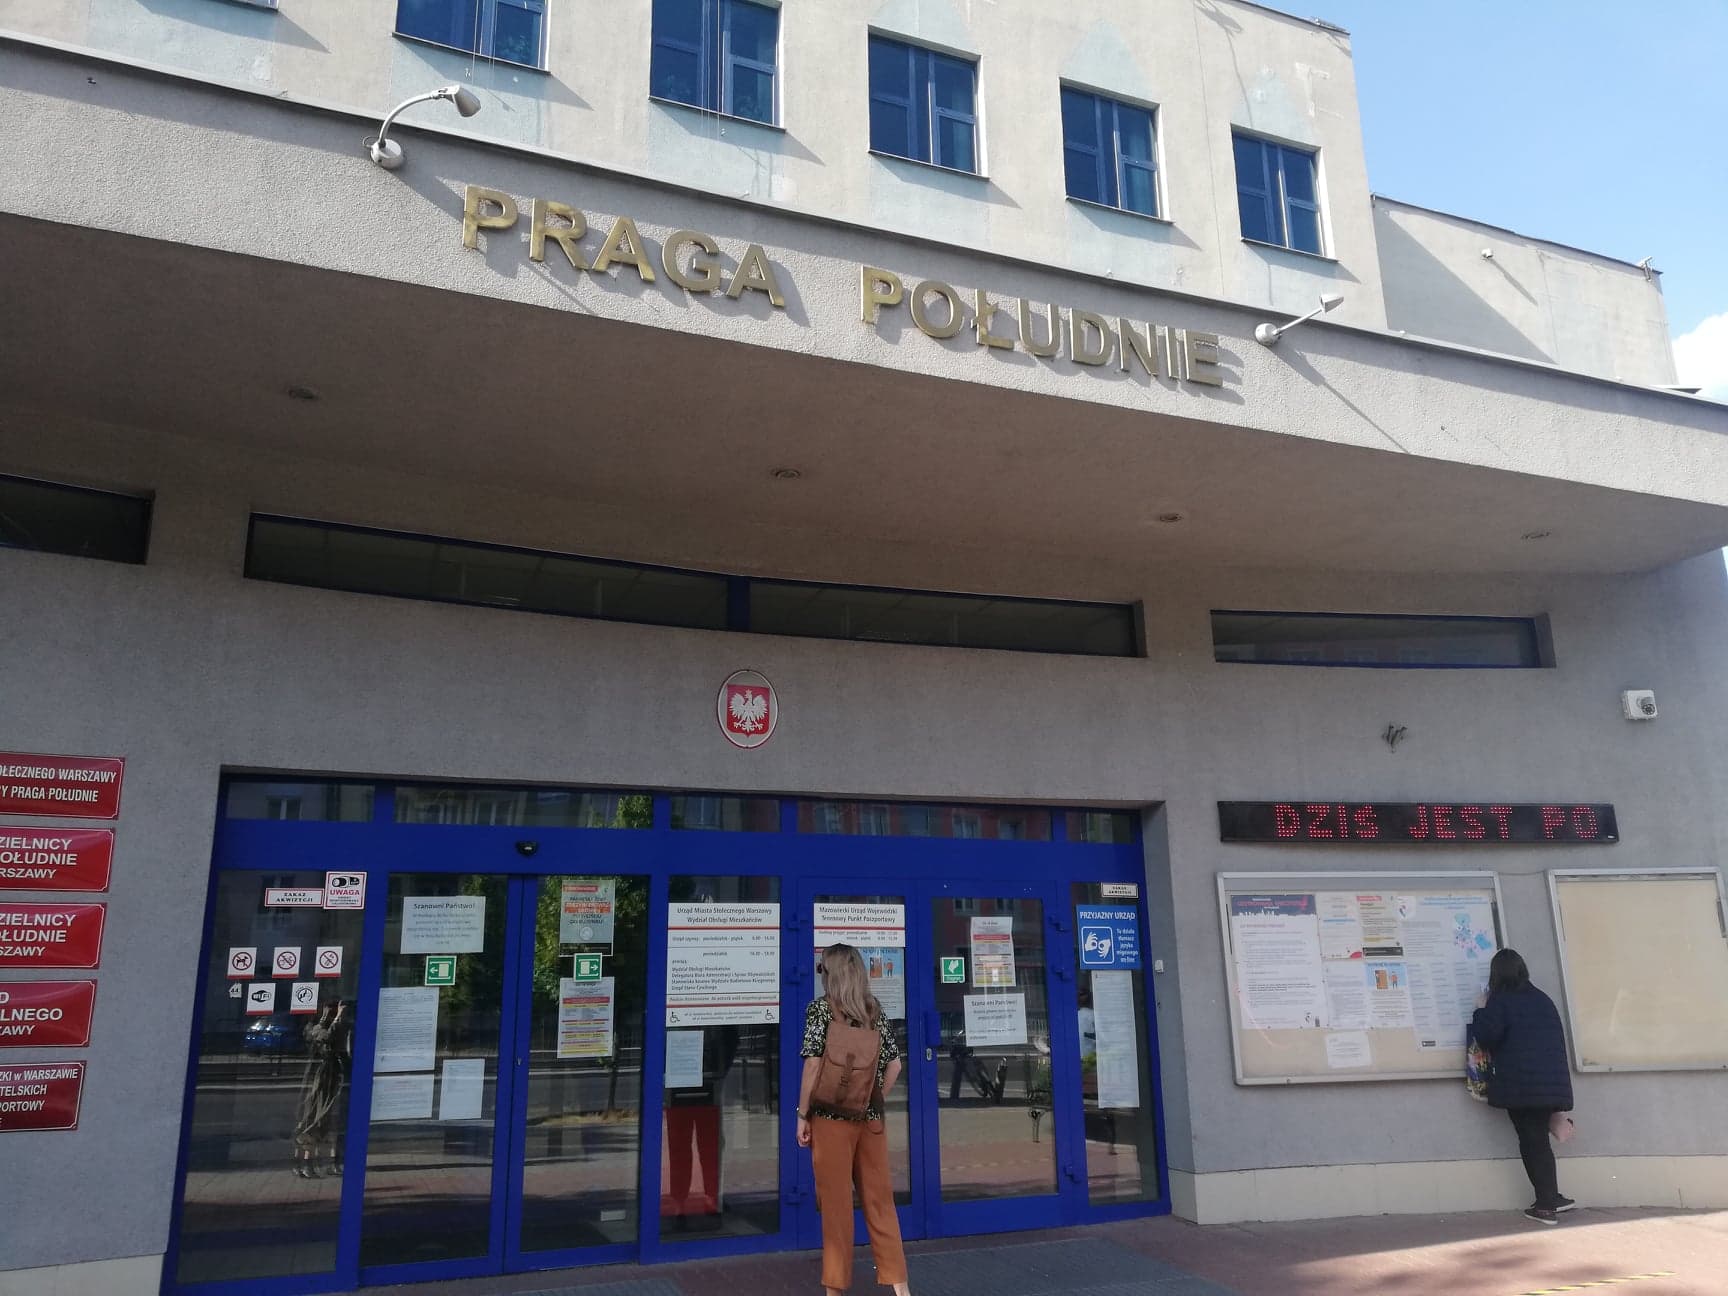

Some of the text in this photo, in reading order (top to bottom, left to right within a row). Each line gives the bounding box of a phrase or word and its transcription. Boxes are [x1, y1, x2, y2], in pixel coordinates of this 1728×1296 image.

[463, 184, 1224, 387] PRAGA POŁUDNIE
[58, 768, 117, 783] WARSZAWY
[11, 786, 45, 799] PRAGA
[48, 788, 99, 802] POŁUDNIE
[1409, 805, 1513, 839] JEST
[1542, 806, 1598, 839] PO
[1080, 911, 1136, 920] PRZYJAZNY URZĄD
[0, 929, 67, 942] ŁUDNIE
[0, 1025, 36, 1036] AWY
[14, 1073, 22, 1081] w
[23, 1069, 79, 1081] WARSZAWIE
[0, 1100, 45, 1112] ORTOWY
